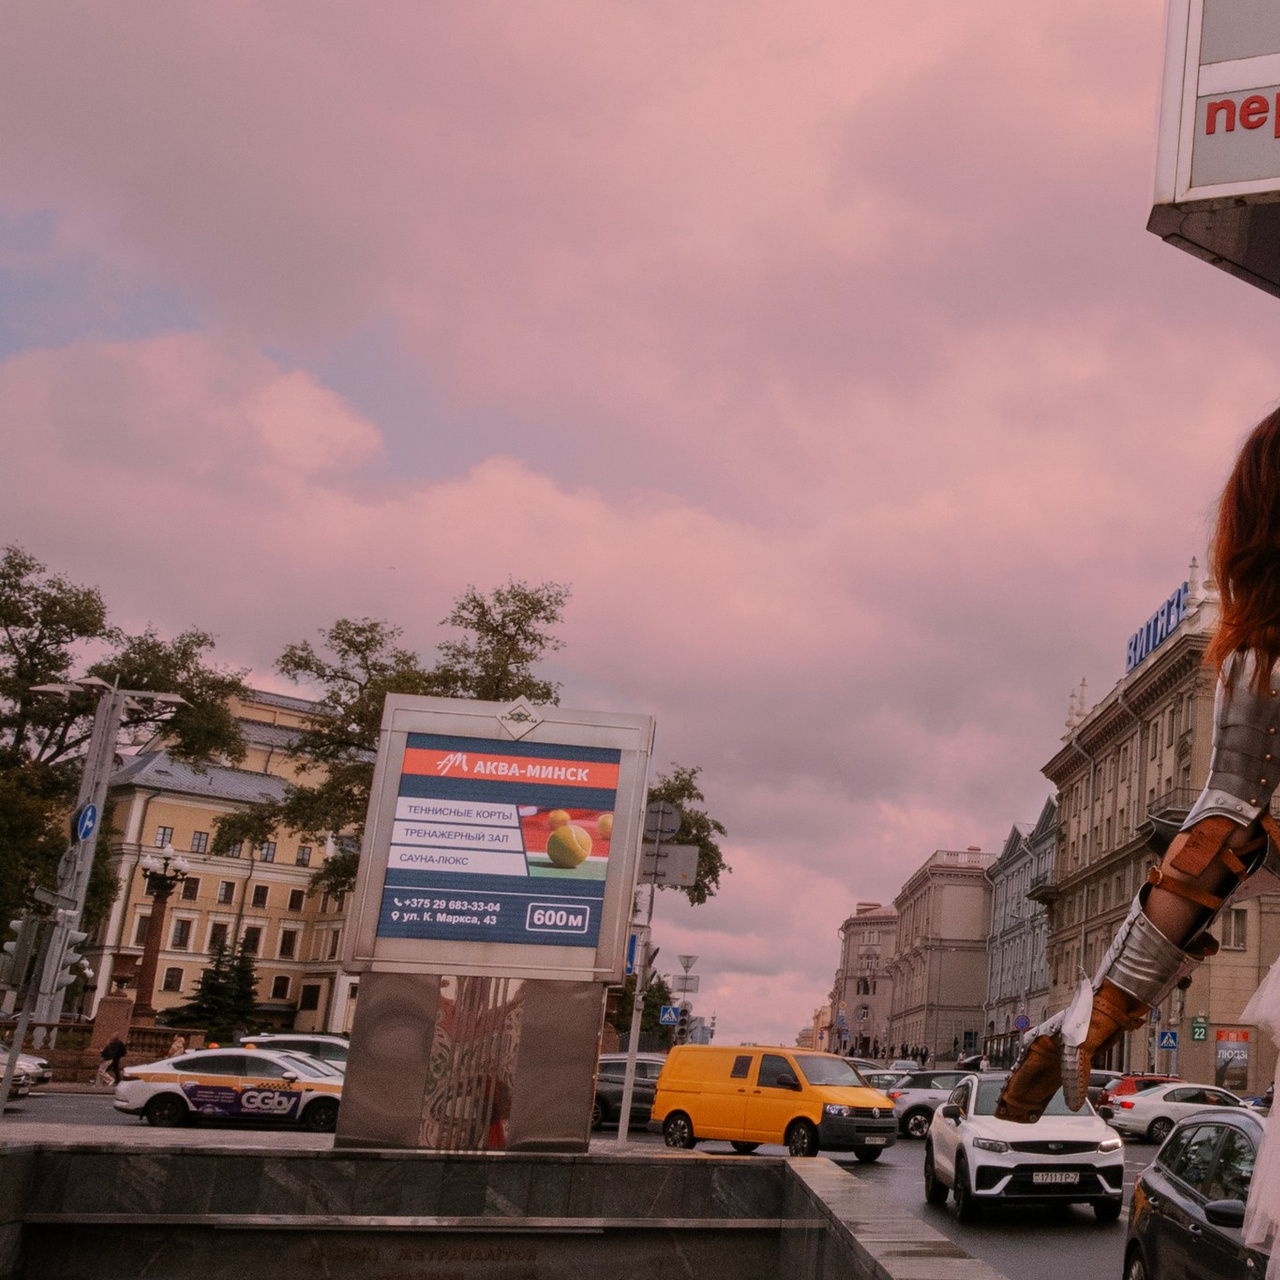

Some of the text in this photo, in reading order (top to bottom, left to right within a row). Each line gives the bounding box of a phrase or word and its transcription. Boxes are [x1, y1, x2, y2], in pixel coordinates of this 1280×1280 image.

[473, 760, 589, 782] АКВА-МИНСК
[407, 805, 513, 821] ТЕННИСНЫЕ КОРТЫ
[404, 828, 509, 843] ТРЕНАЖЕРНЫЙ ЗАЛ
[399, 853, 469, 866] САУНА-ЛЮКС
[404, 898, 501, 912] +375 29 683-33-04
[402, 912, 497, 925] ул. К. Маркса, 43
[1194, 1028, 1205, 1040] 22
